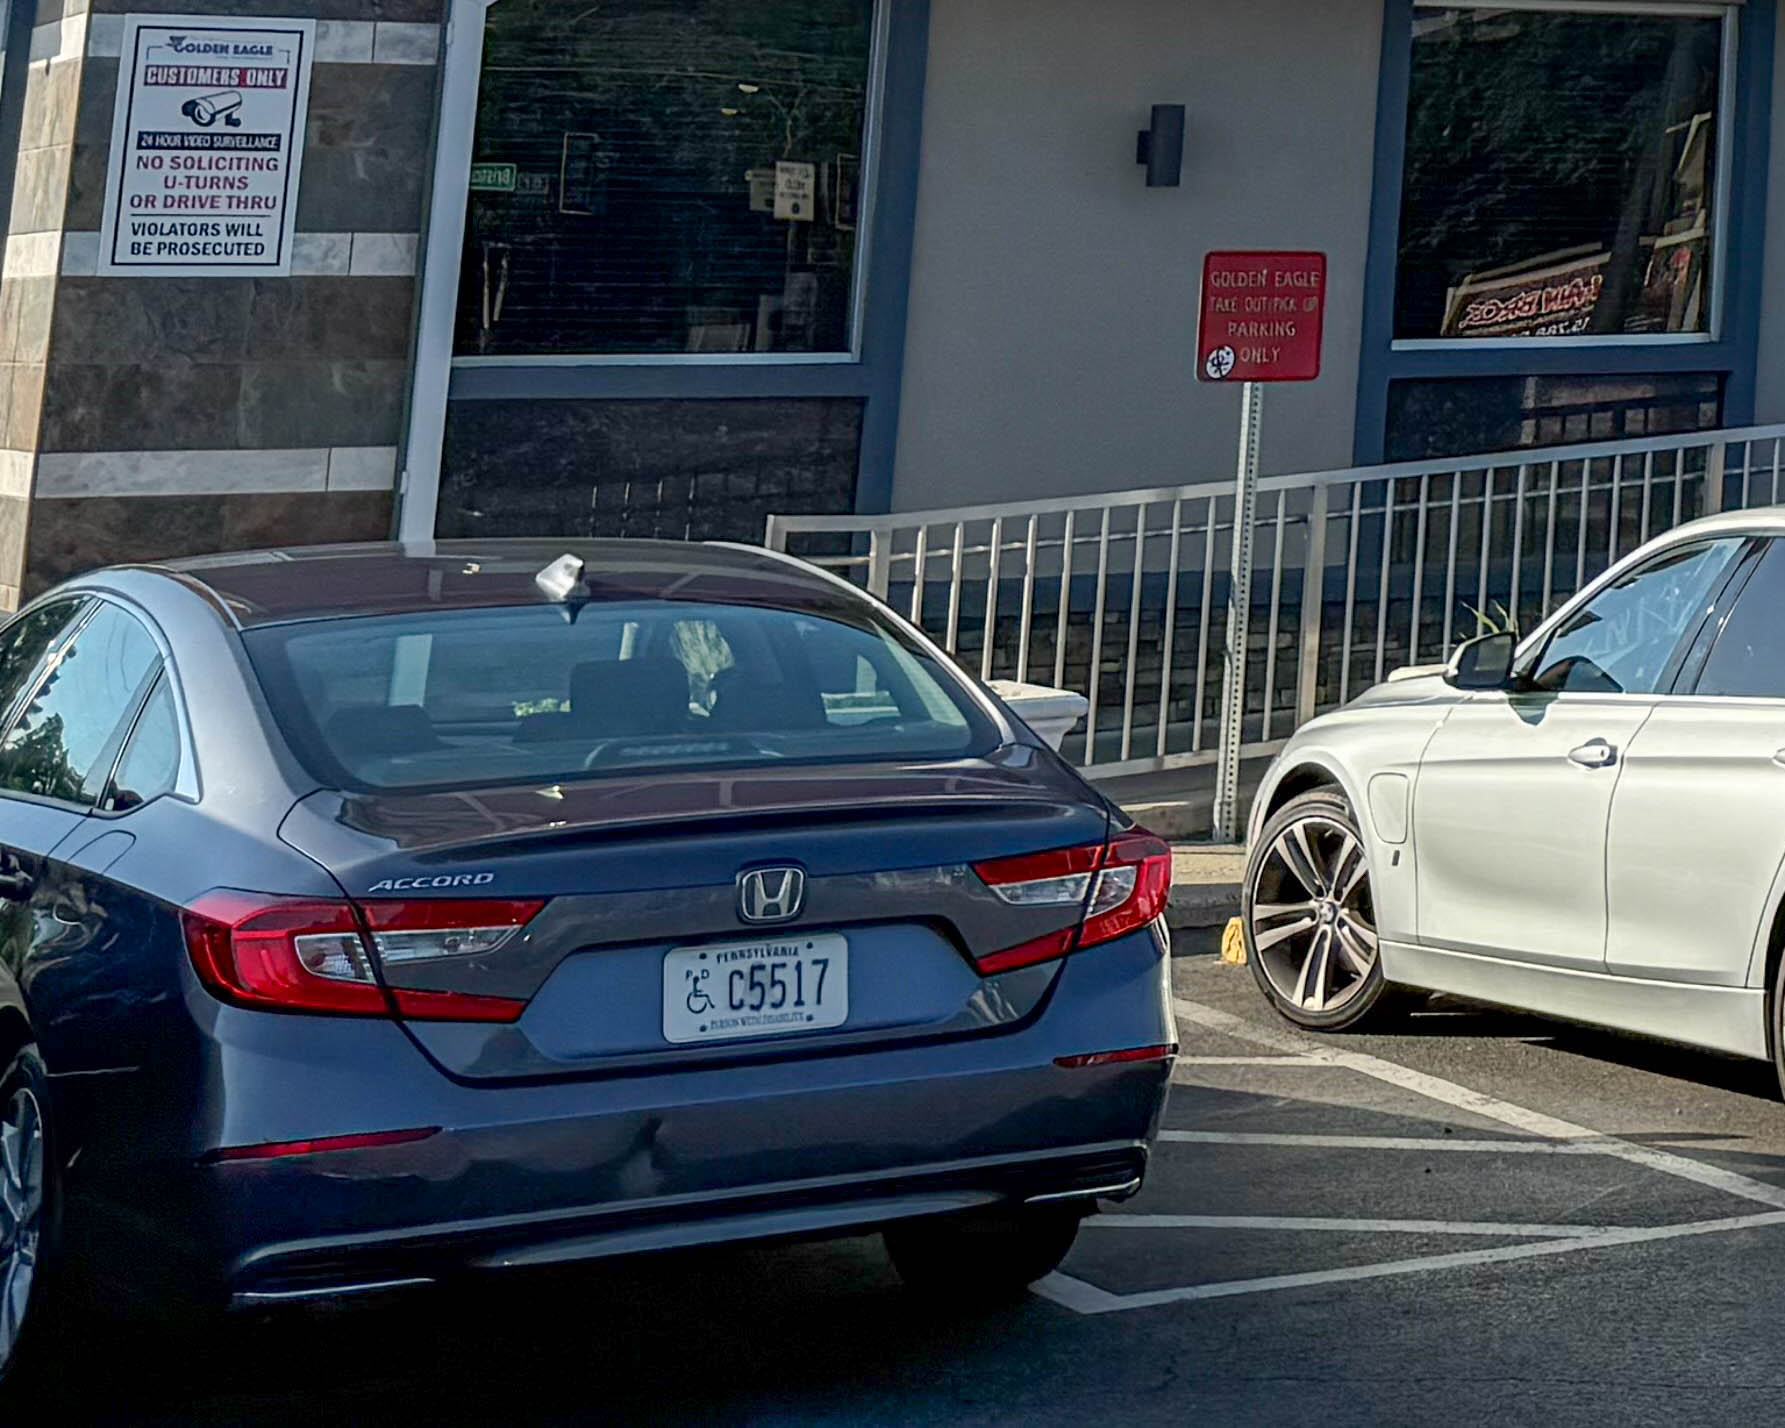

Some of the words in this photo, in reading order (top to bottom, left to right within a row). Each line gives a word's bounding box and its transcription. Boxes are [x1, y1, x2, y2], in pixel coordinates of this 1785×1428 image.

[174, 42, 229, 55] GOLDEN
[234, 45, 273, 56] EAGLE
[147, 67, 240, 86] CUSTOMERS
[246, 69, 286, 88] ONLY
[136, 155, 164, 170] NO
[169, 156, 279, 171] SOLICITING
[163, 176, 249, 190] U-TURNS
[130, 194, 156, 209] OR
[163, 195, 220, 209] DRIVE
[227, 195, 277, 210] THRU
[131, 223, 220, 237] VIOLATORS
[226, 223, 263, 237] WILL
[130, 242, 152, 256] BE
[157, 242, 265, 256] PROSECUTED
[1211, 270, 1267, 287] GOLDEN
[1274, 271, 1320, 287] EAGLE
[1209, 296, 1238, 312] TAKE
[1228, 321, 1296, 337] PARKING
[1240, 347, 1280, 363] ONLY
[368, 872, 494, 893] ACCORD
[716, 945, 800, 964] PENNSYLVANIA
[728, 957, 829, 1012] C5517
